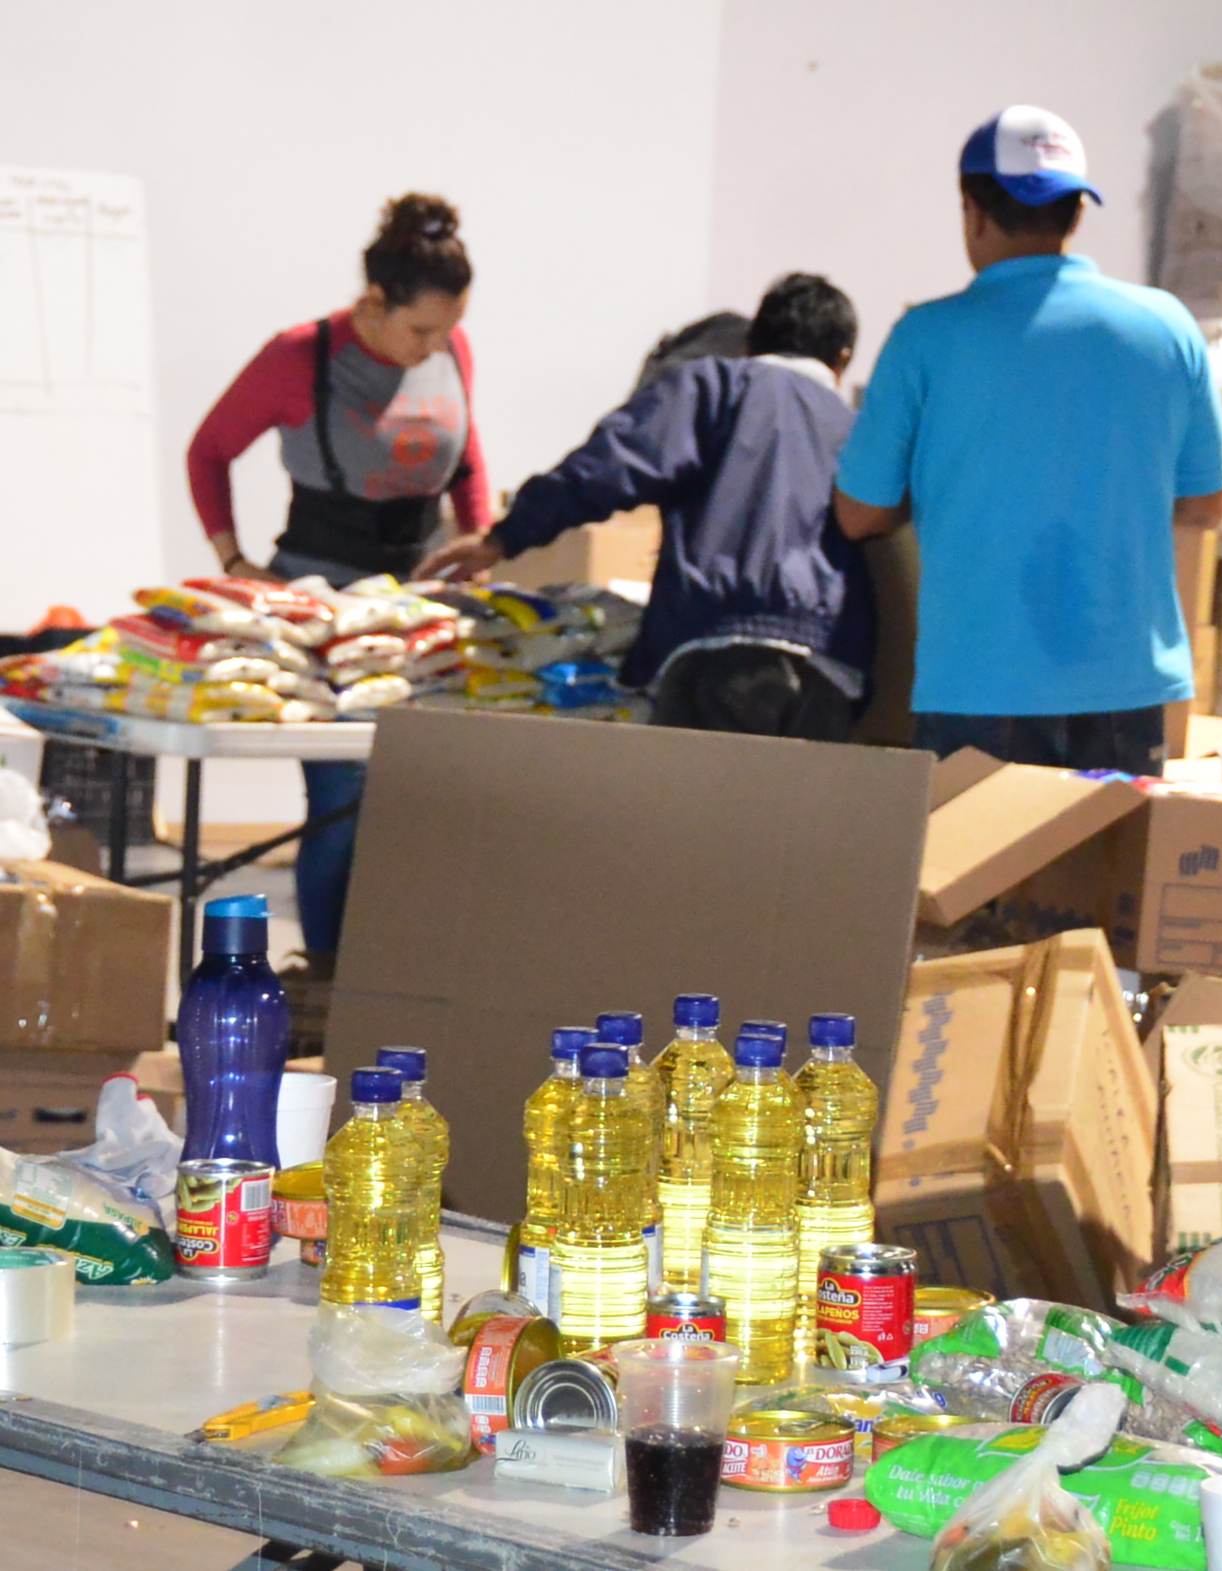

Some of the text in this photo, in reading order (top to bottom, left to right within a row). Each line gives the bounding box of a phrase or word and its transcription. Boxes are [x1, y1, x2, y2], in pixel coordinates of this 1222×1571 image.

[824, 1281, 835, 1292] La
[818, 1289, 855, 1305] osteña
[682, 1323, 693, 1333] La
[815, 1441, 852, 1460] DORA
[1115, 1499, 1160, 1521] Frijol
[1110, 1517, 1158, 1542] Pinto
